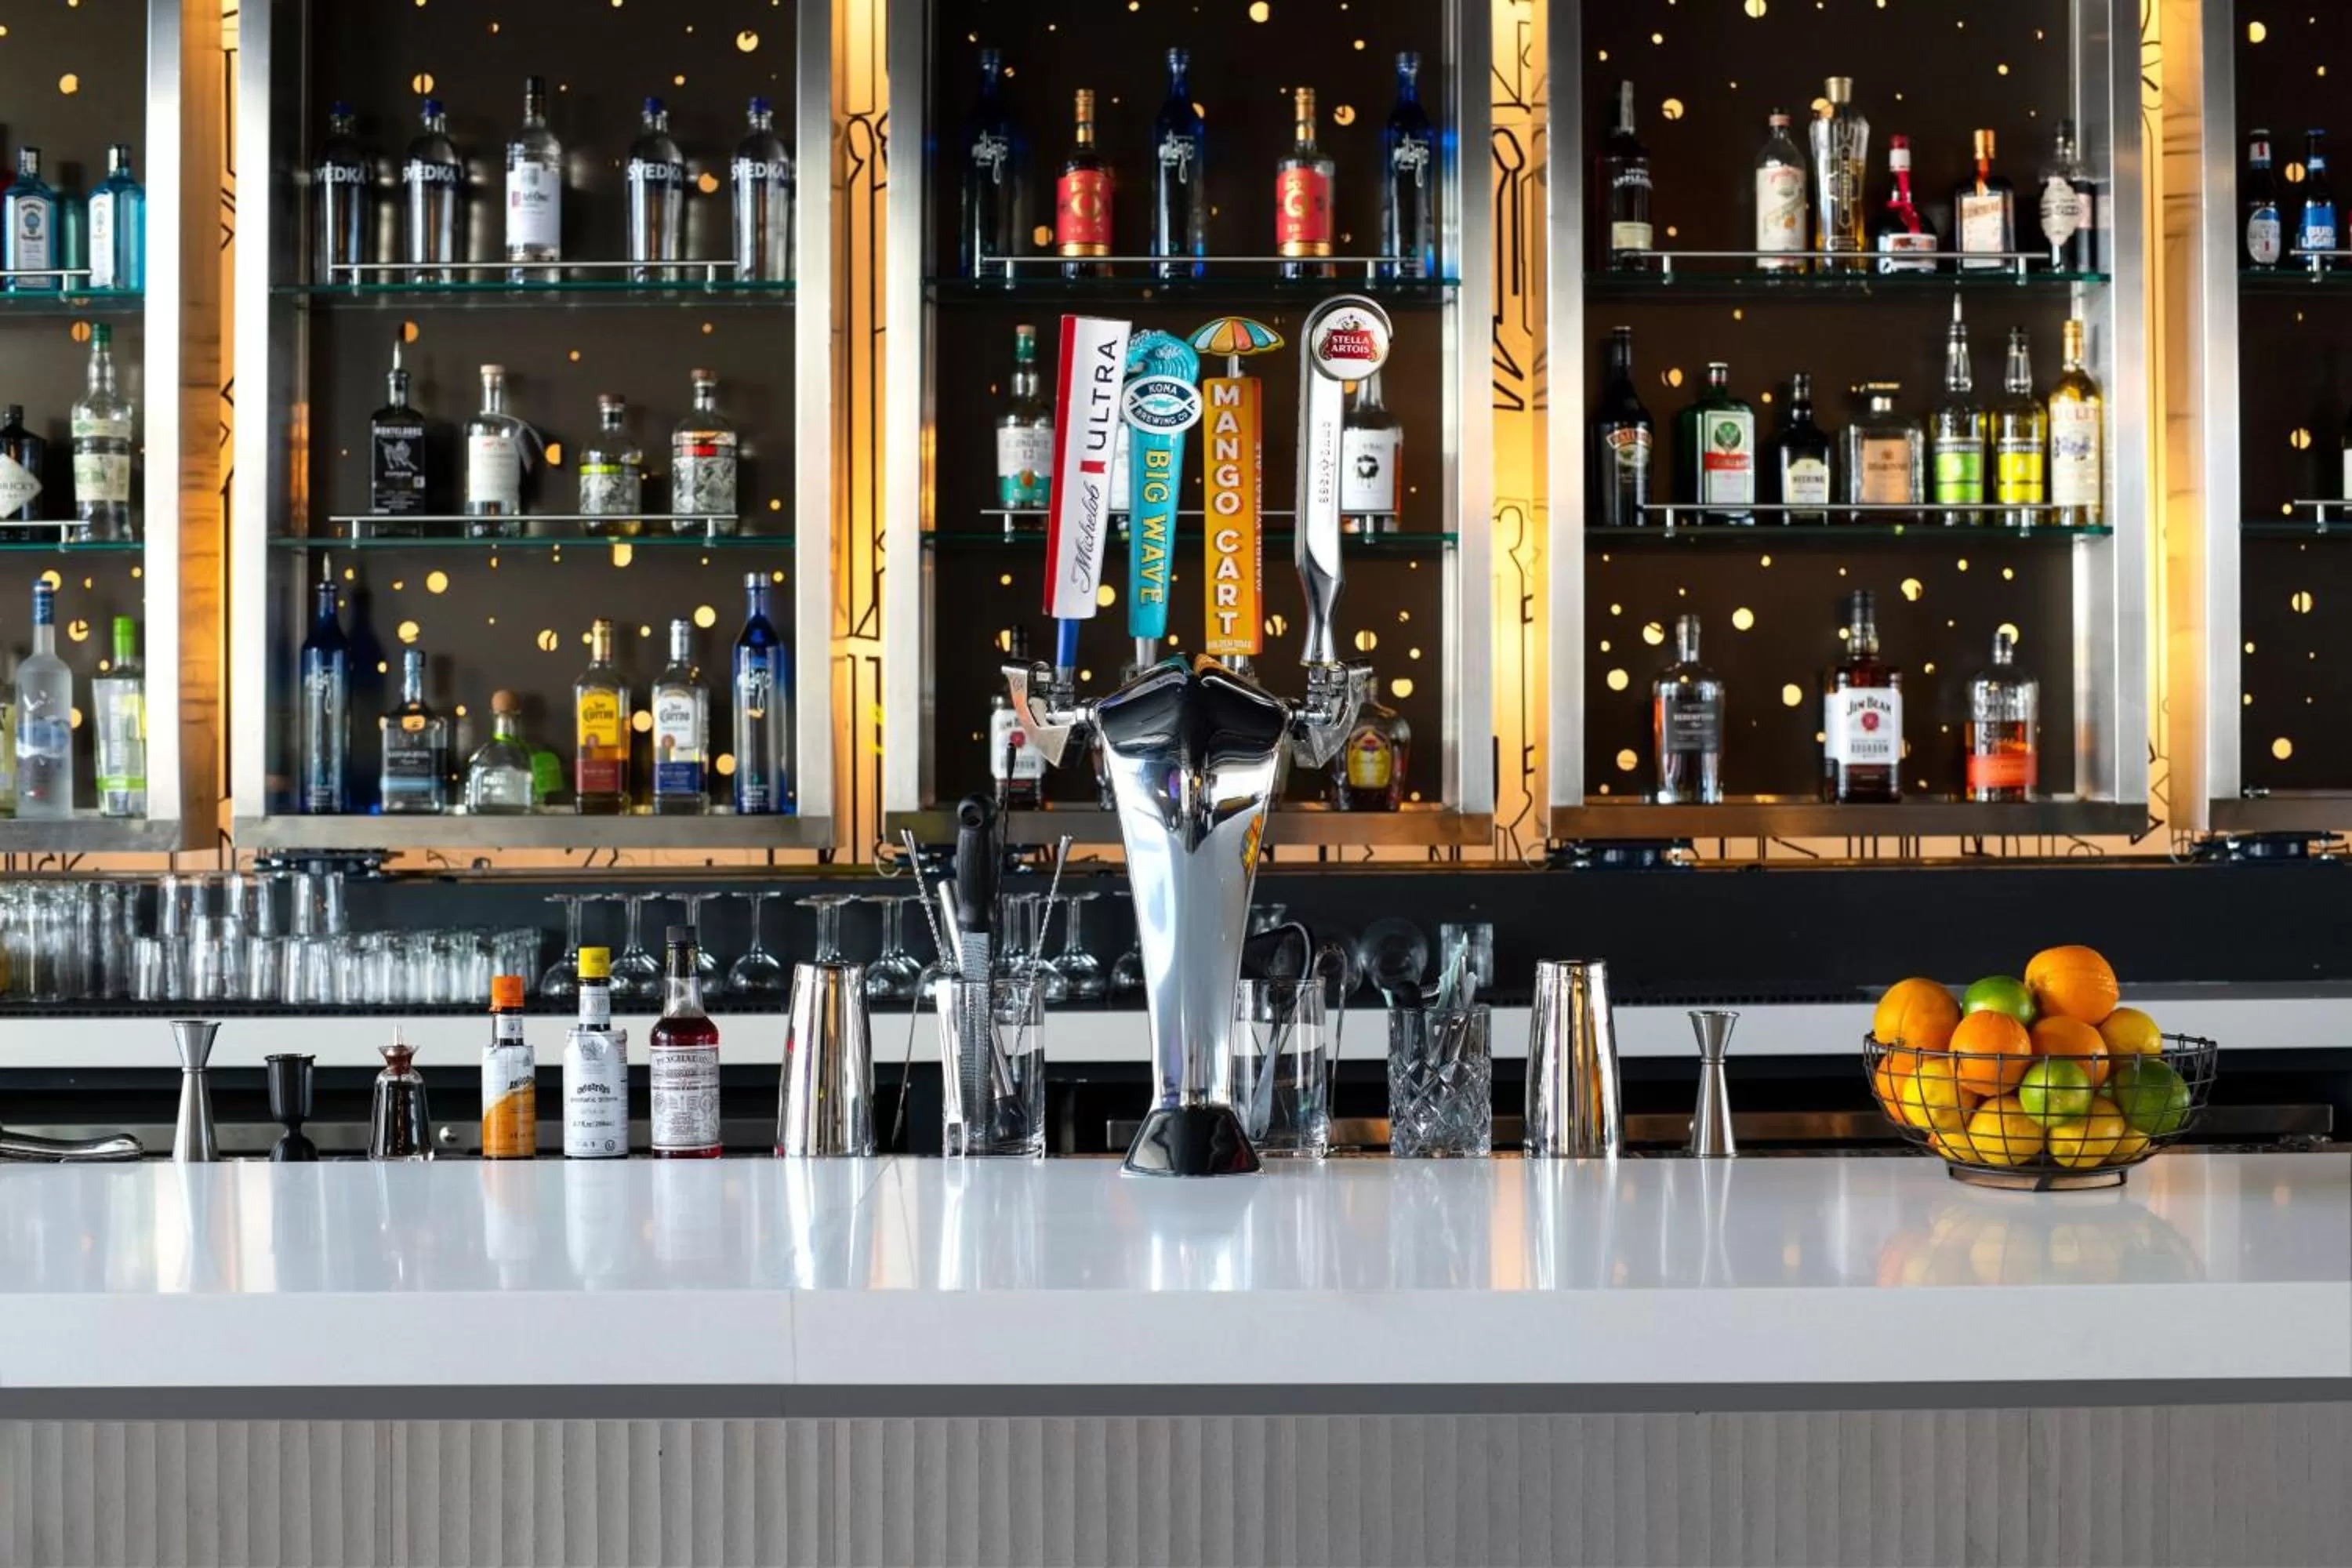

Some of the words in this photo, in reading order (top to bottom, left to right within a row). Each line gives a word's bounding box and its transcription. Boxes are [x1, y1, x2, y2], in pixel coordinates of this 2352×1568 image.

[1331, 344, 1370, 354] ARTOIS
[1332, 335, 1370, 344] STELLA
[1134, 408, 1177, 424] BREWING
[1148, 383, 1178, 394] KONA
[1071, 480, 1100, 594] Michelob
[1087, 339, 1118, 452] ULTRA
[1142, 449, 1172, 504] BIG
[1212, 383, 1241, 516] MANGO
[1140, 513, 1167, 605] WAVE
[1214, 529, 1241, 635] CART
